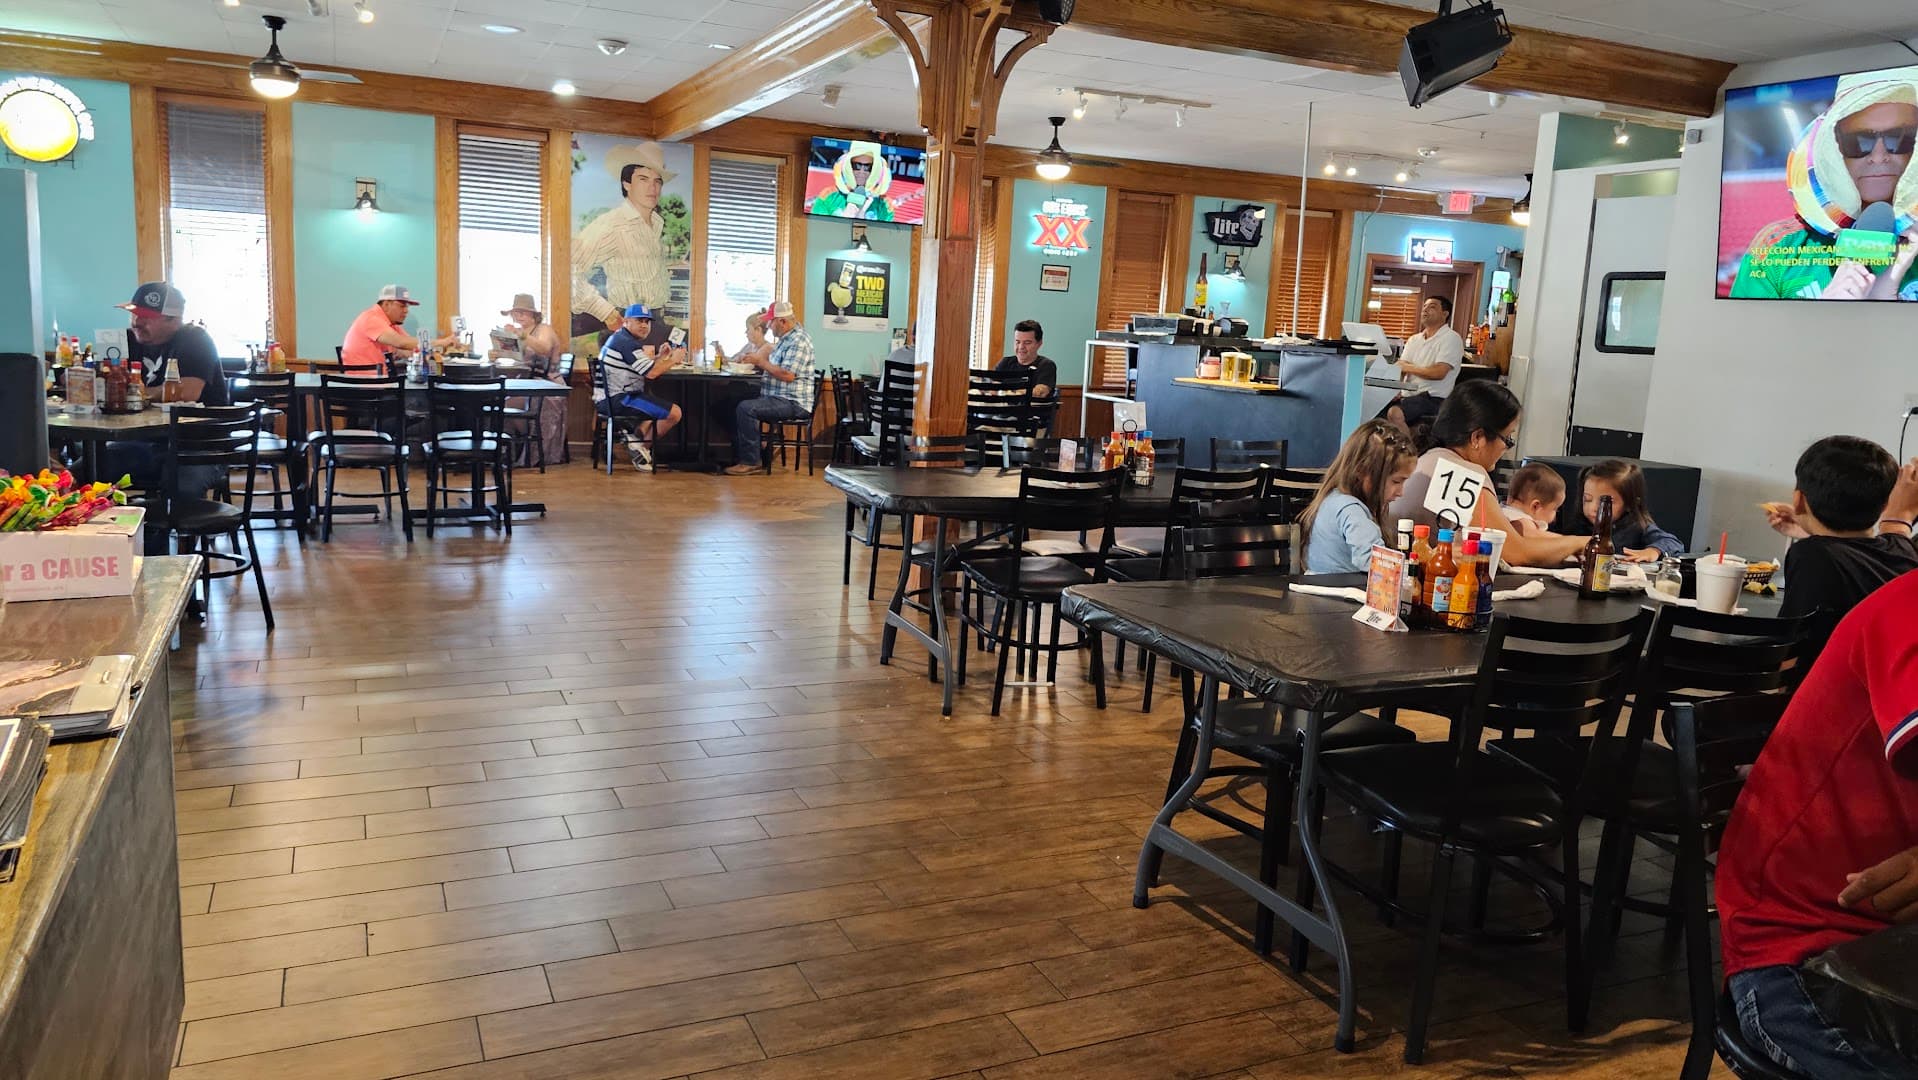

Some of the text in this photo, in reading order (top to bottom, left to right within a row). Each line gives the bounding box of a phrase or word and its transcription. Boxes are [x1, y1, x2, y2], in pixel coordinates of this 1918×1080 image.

[1033, 215, 1090, 249] XX
[1213, 217, 1240, 238] Lite
[1775, 258, 1811, 267] PUEDEN
[856, 276, 885, 290] TWO
[856, 304, 883, 314] IN ONE
[671, 329, 681, 341] 2
[1440, 470, 1480, 509] 15
[21, 563, 36, 581] a
[41, 556, 119, 580] CAUSE
